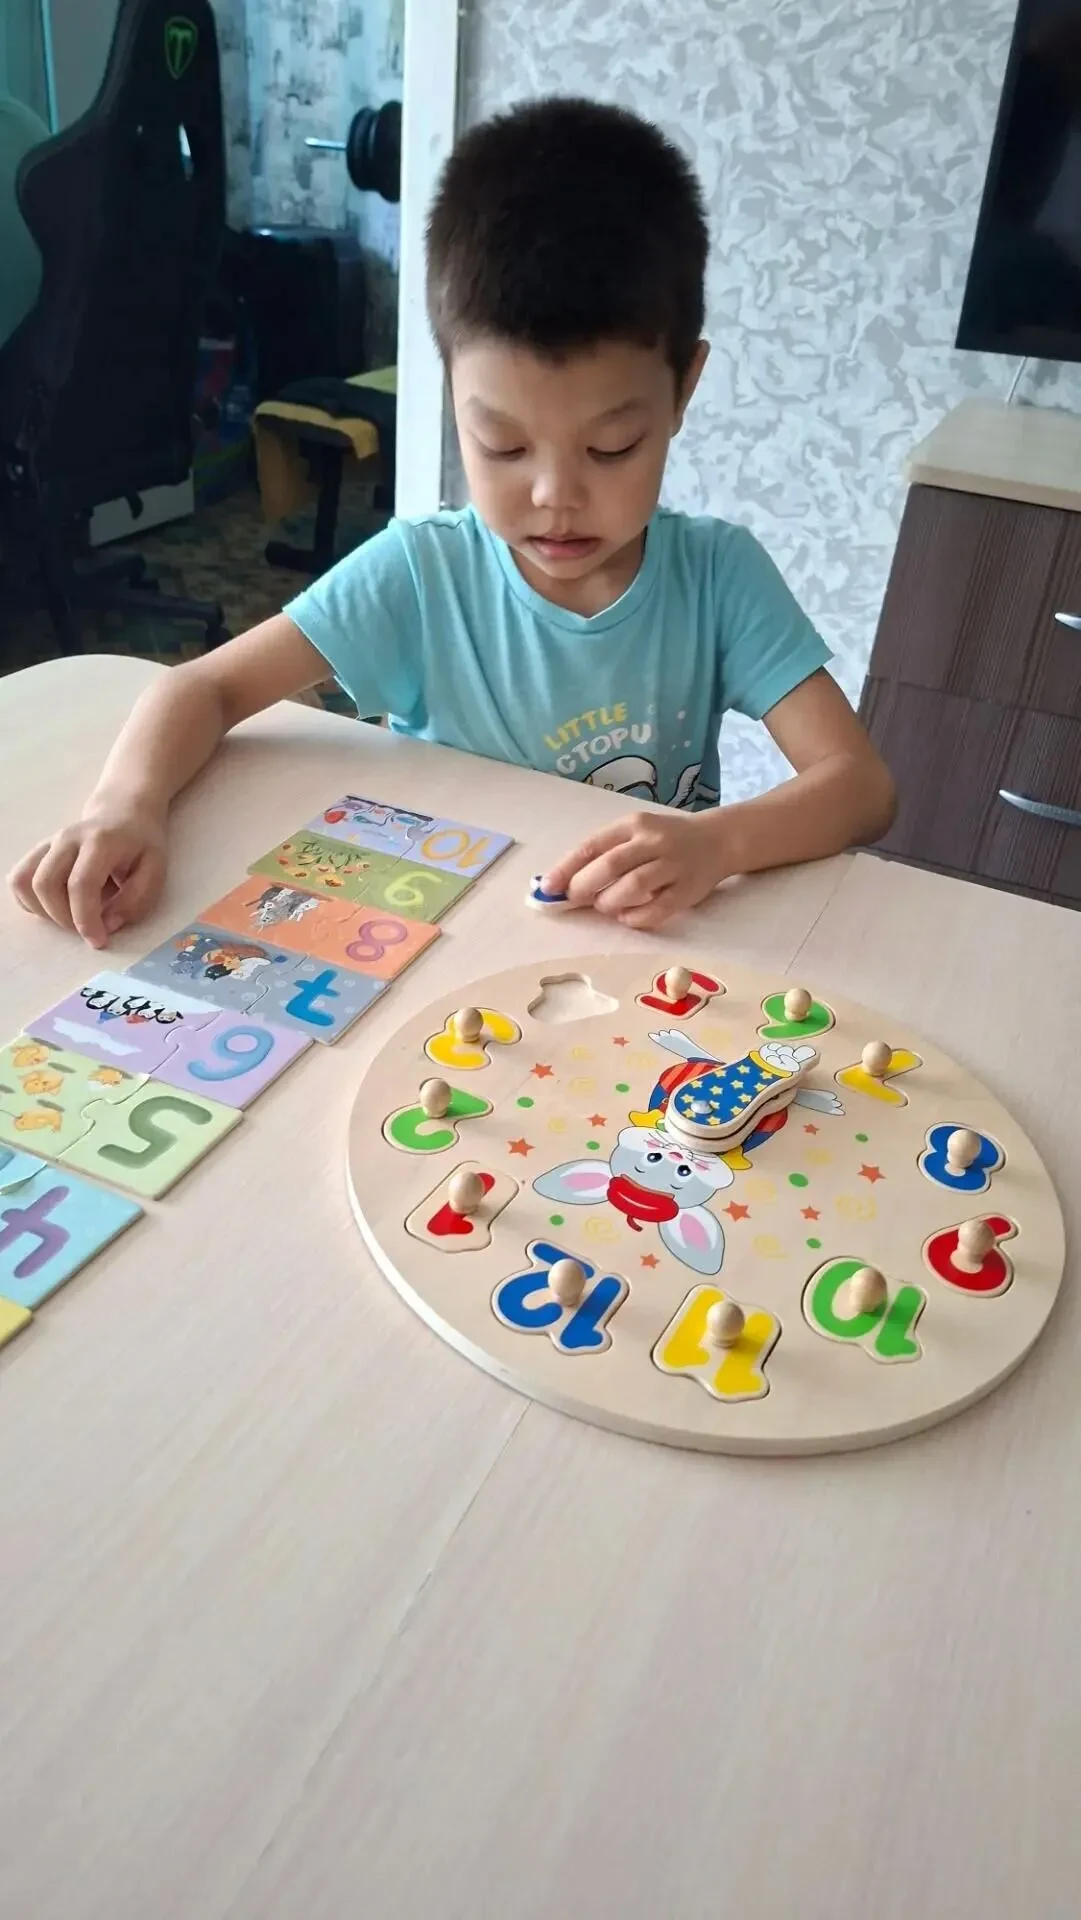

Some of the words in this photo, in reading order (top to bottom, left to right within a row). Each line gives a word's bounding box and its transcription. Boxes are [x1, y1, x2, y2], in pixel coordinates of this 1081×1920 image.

[544, 701, 628, 750] LITTLE
[553, 723, 652, 775] CTOPU
[420, 828, 488, 868] 10
[384, 870, 442, 906] 9
[345, 919, 408, 962] 8
[285, 969, 339, 1027] 7
[187, 1025, 275, 1081] 6
[98, 1096, 212, 1169] 5
[924, 1126, 1000, 1191] 8
[0, 1186, 70, 1279] 4
[499, 1242, 622, 1349] 12
[813, 1260, 926, 1357] 10
